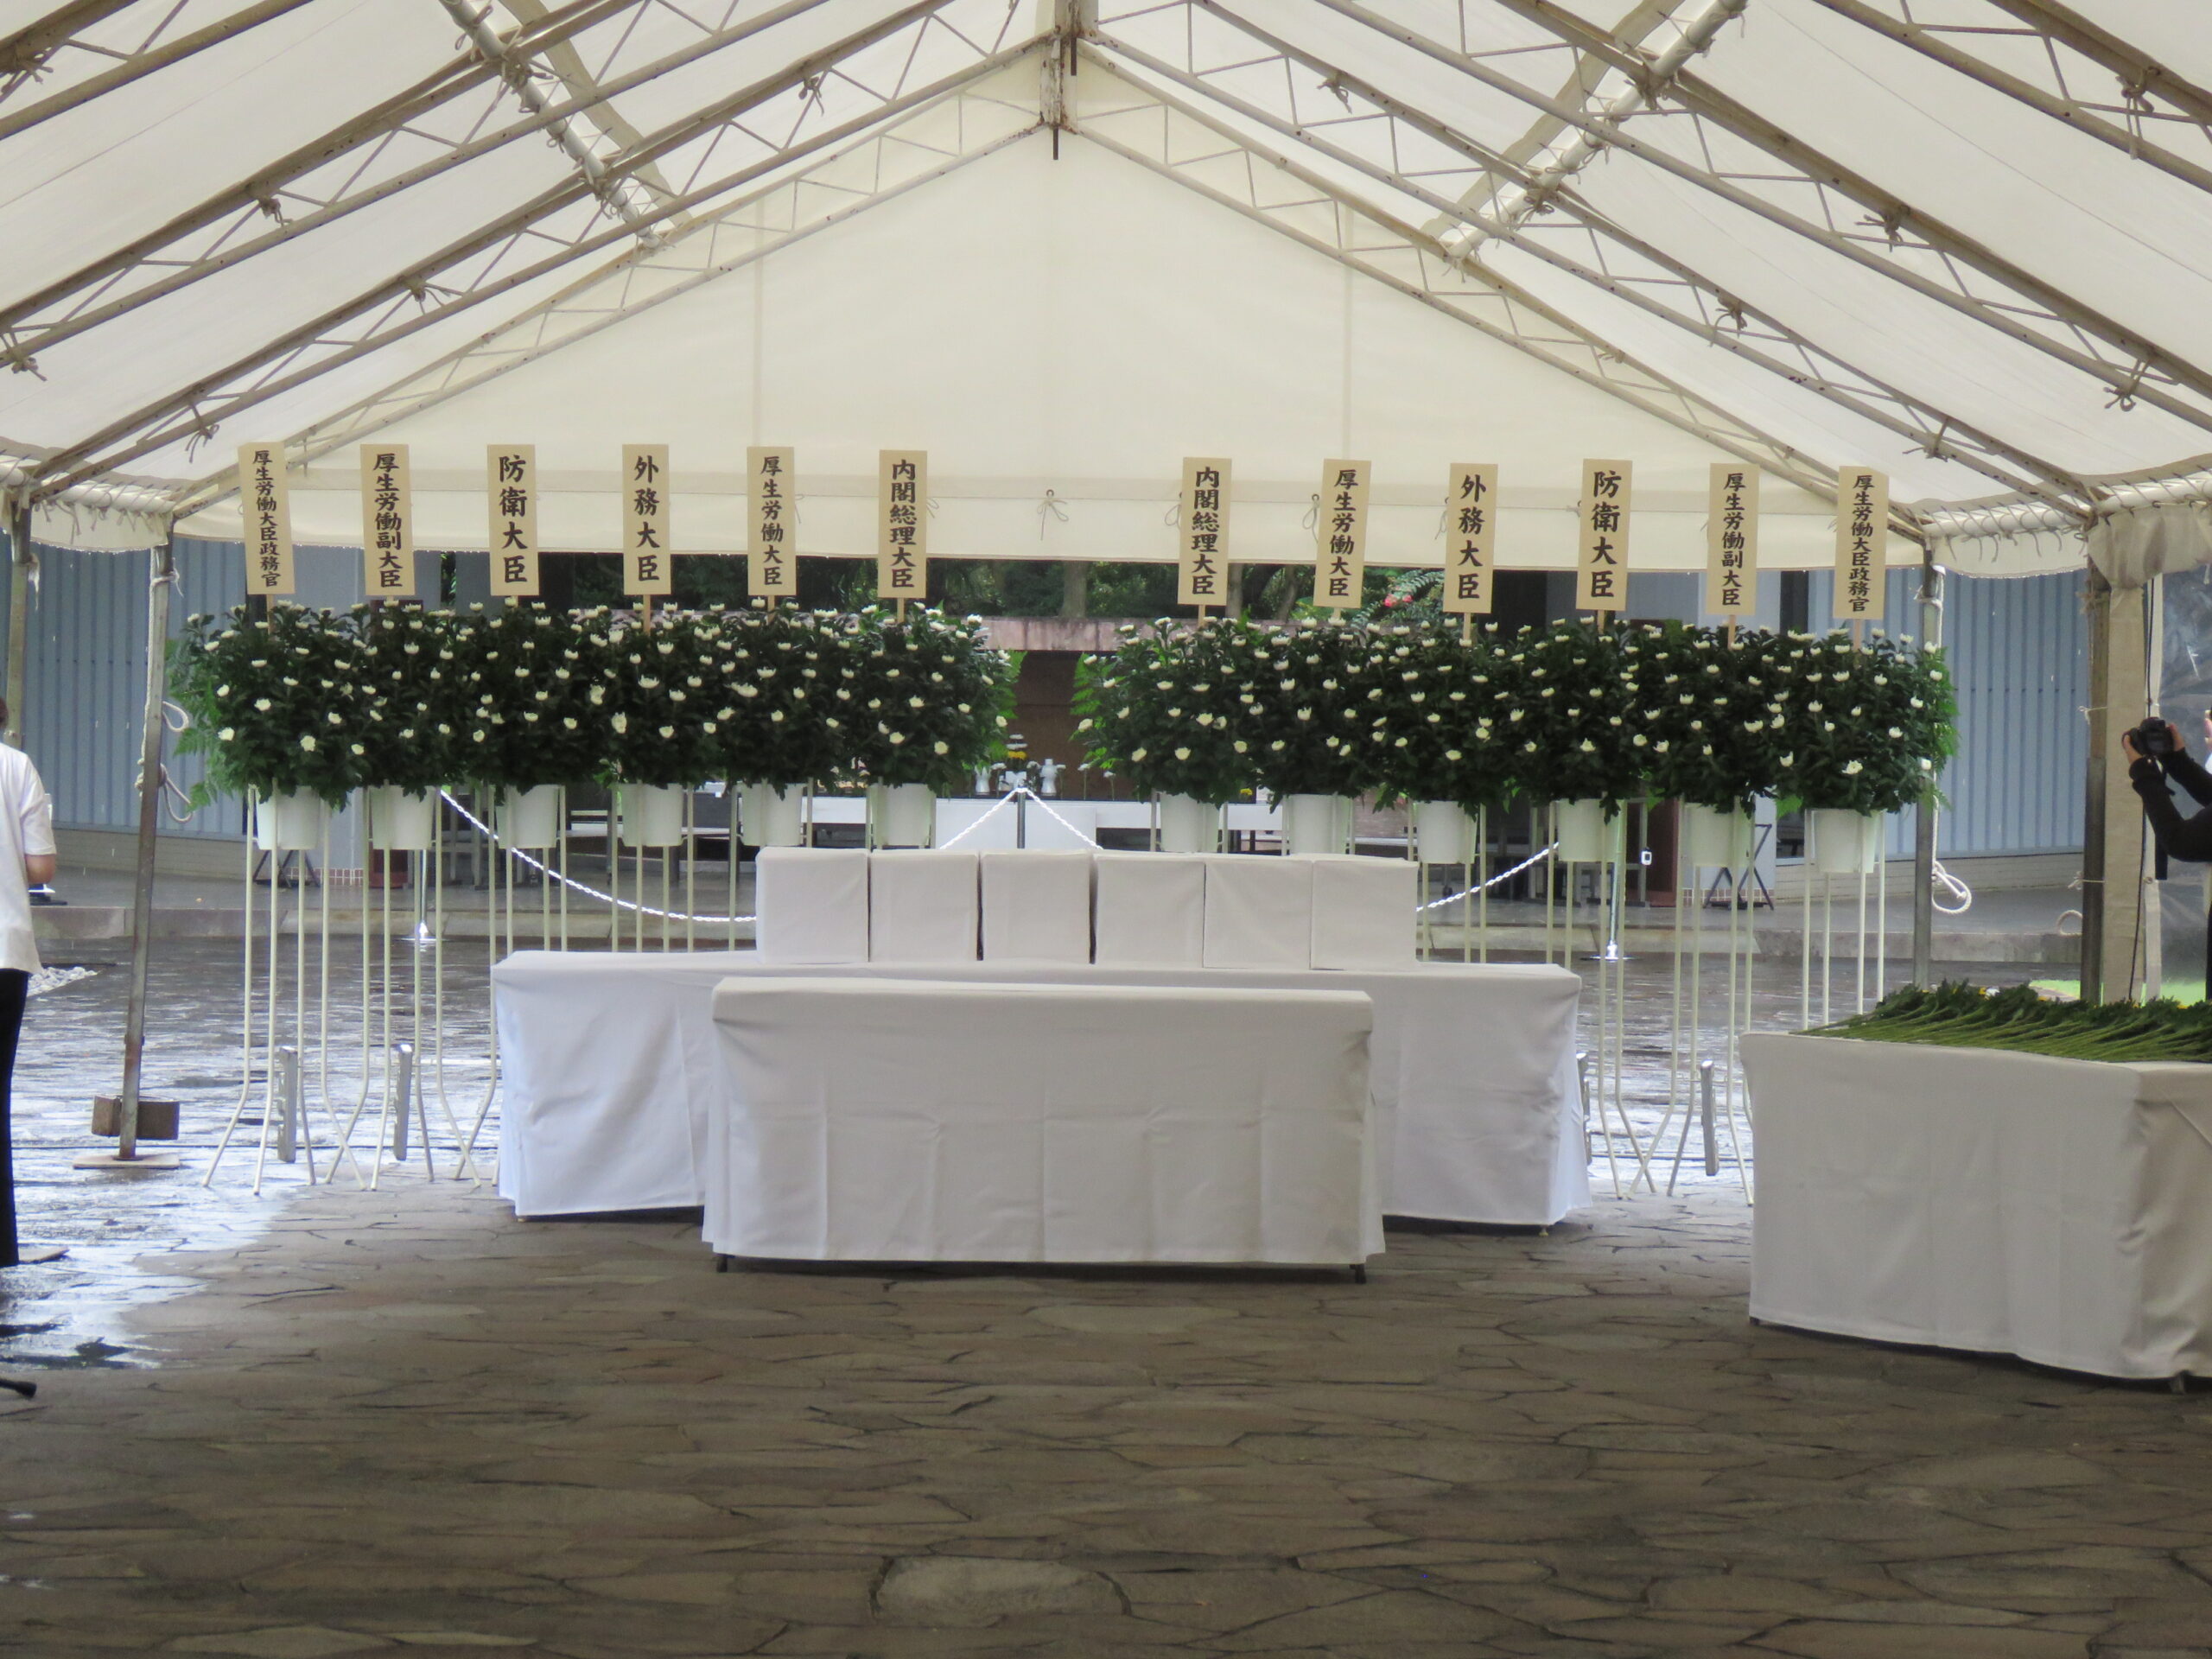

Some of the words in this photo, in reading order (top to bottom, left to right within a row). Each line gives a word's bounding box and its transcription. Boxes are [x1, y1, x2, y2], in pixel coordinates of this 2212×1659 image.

[252, 449, 281, 588] 厚生労働大臣政務官
[373, 453, 404, 588] 厚生労働副大臣
[499, 454, 528, 583] 防衛大臣
[633, 455, 660, 582] 外務大臣
[760, 455, 784, 586] 厚生労働大臣
[889, 459, 917, 588] 内閣総理大臣
[1191, 467, 1219, 595] 内閣総理大臣
[1329, 469, 1358, 597] 厚生労働大臣
[1458, 474, 1486, 600] 外務大臣
[1591, 470, 1622, 598] 防衛大臣
[1721, 473, 1746, 607] 厚生労働副大臣
[1848, 475, 1875, 613] 厚生労働大臣政務官
